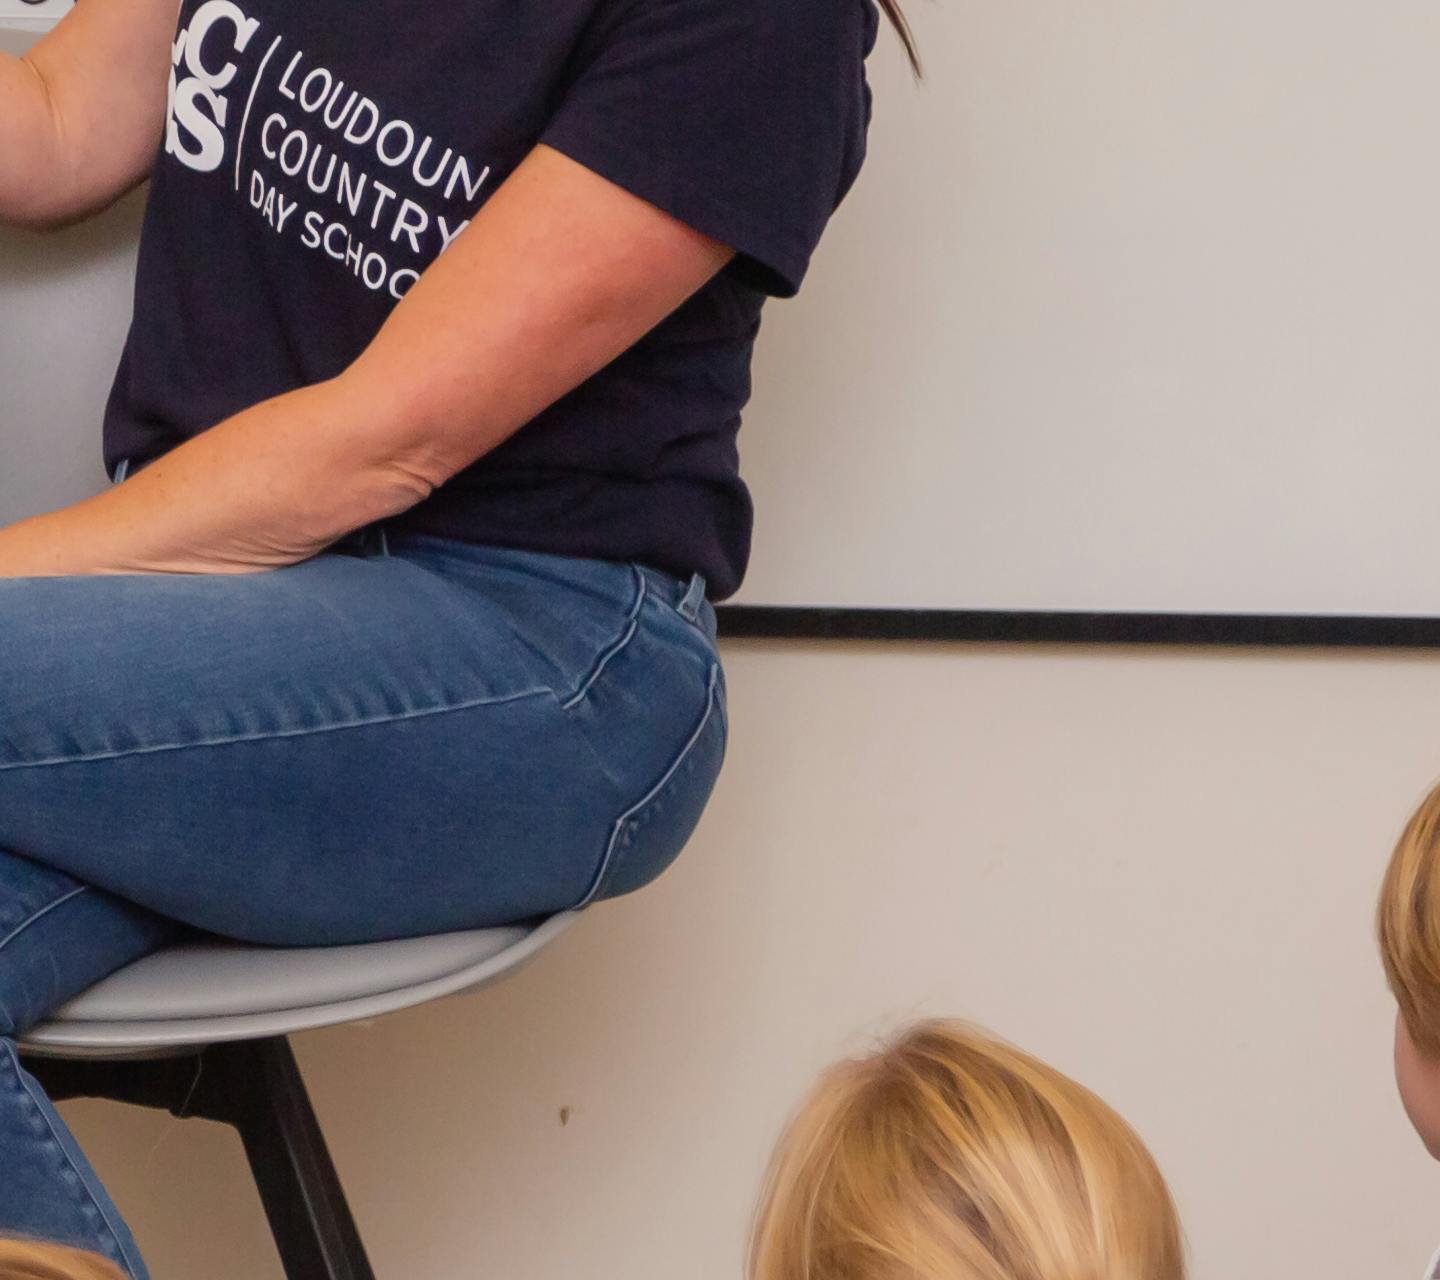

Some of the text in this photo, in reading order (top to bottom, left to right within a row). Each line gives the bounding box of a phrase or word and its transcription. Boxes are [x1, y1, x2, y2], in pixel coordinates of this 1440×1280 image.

[261, 112, 472, 257] COUNTRY
[279, 51, 490, 202] LOUDOUN
[250, 170, 421, 300] DAY SCHOO
